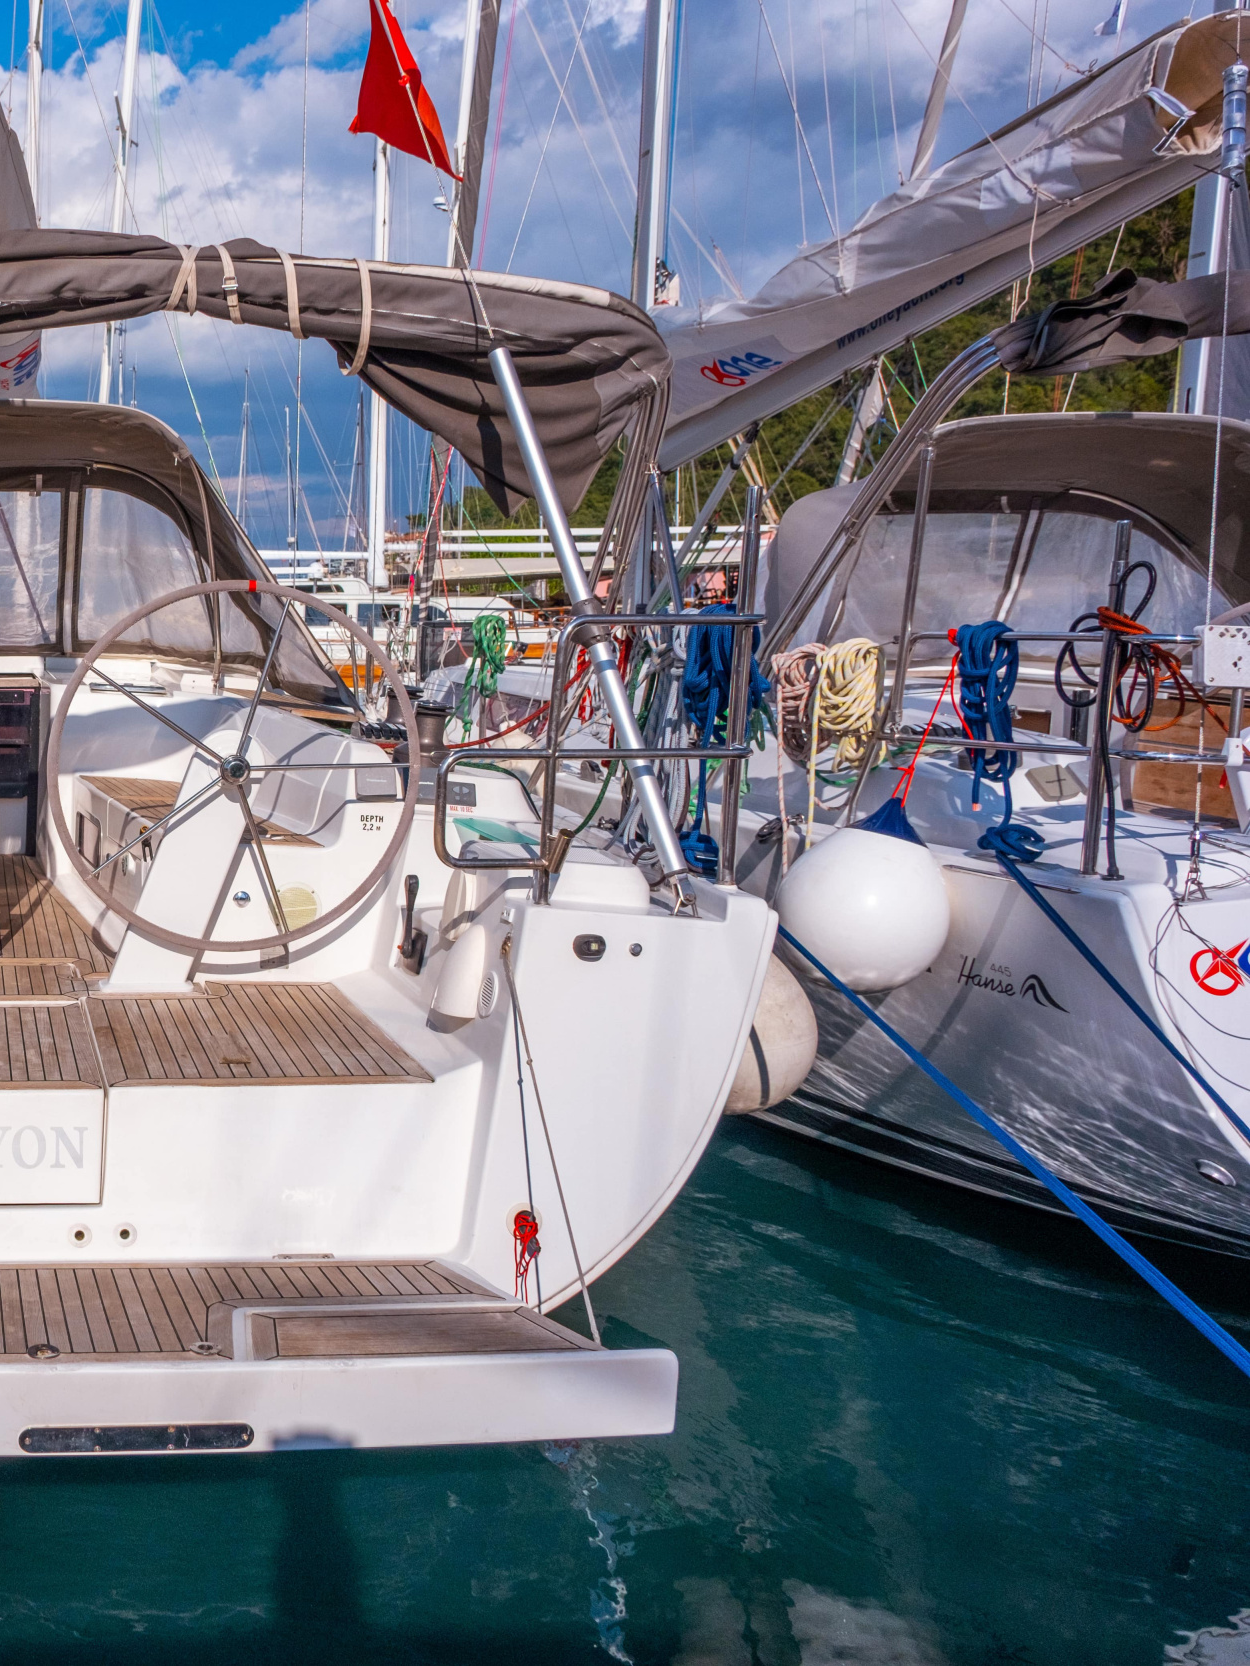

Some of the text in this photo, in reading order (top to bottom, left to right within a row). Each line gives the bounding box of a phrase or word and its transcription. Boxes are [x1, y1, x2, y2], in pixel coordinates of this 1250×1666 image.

[717, 352, 783, 377] one
[360, 814, 384, 822] DEPTH
[957, 955, 1016, 997] Hanse
[990, 963, 1012, 977] 445
